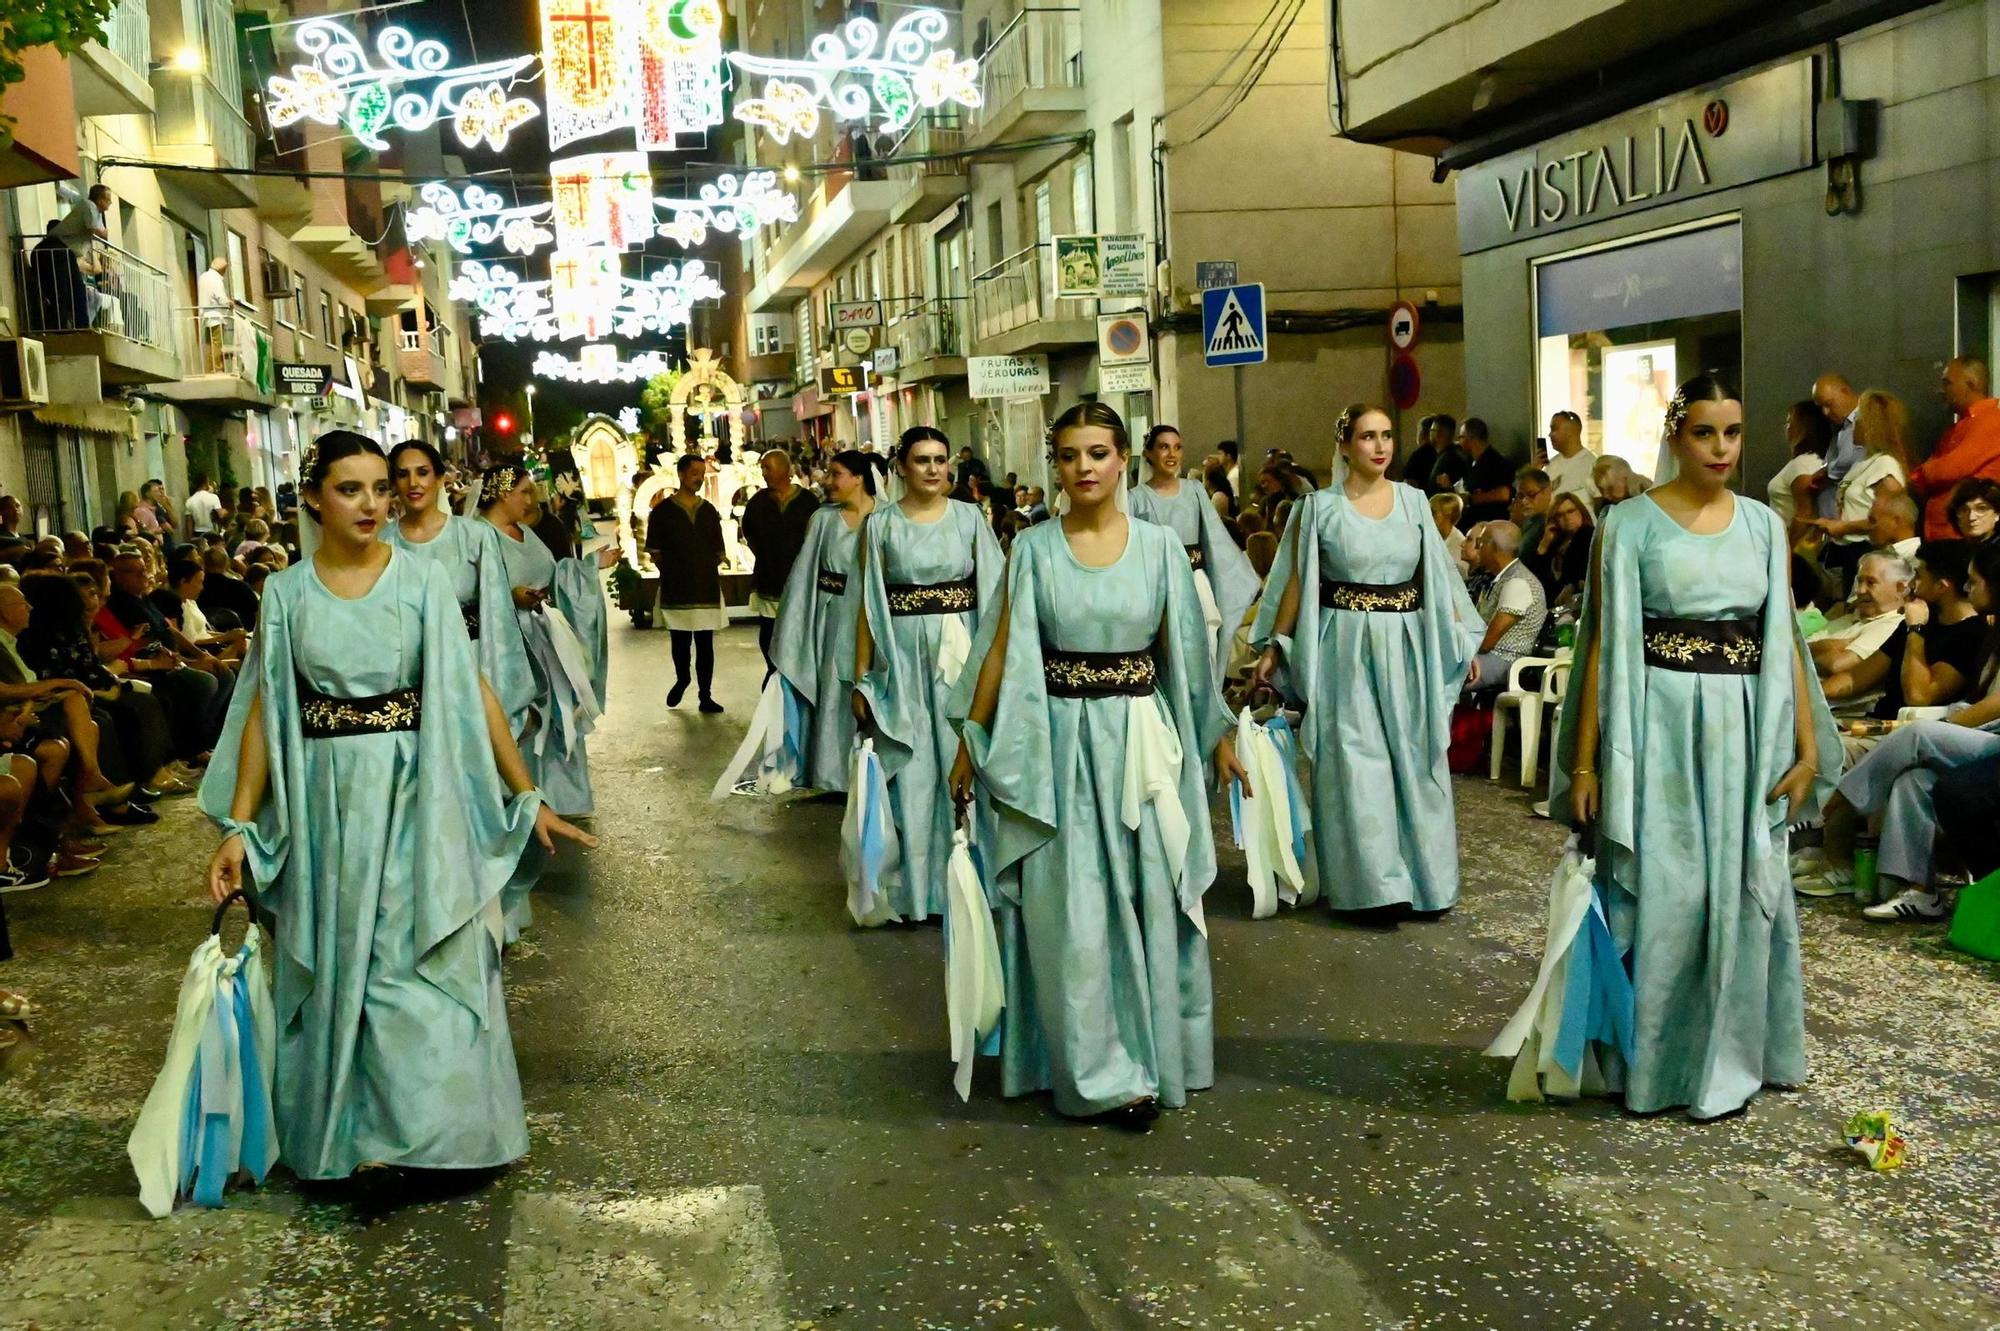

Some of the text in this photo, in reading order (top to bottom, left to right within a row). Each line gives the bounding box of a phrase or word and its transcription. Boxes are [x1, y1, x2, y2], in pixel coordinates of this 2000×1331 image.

[1497, 119, 1711, 231] VISTALIA
[282, 367, 323, 378] QUESADA
[291, 383, 317, 393] BIKES
